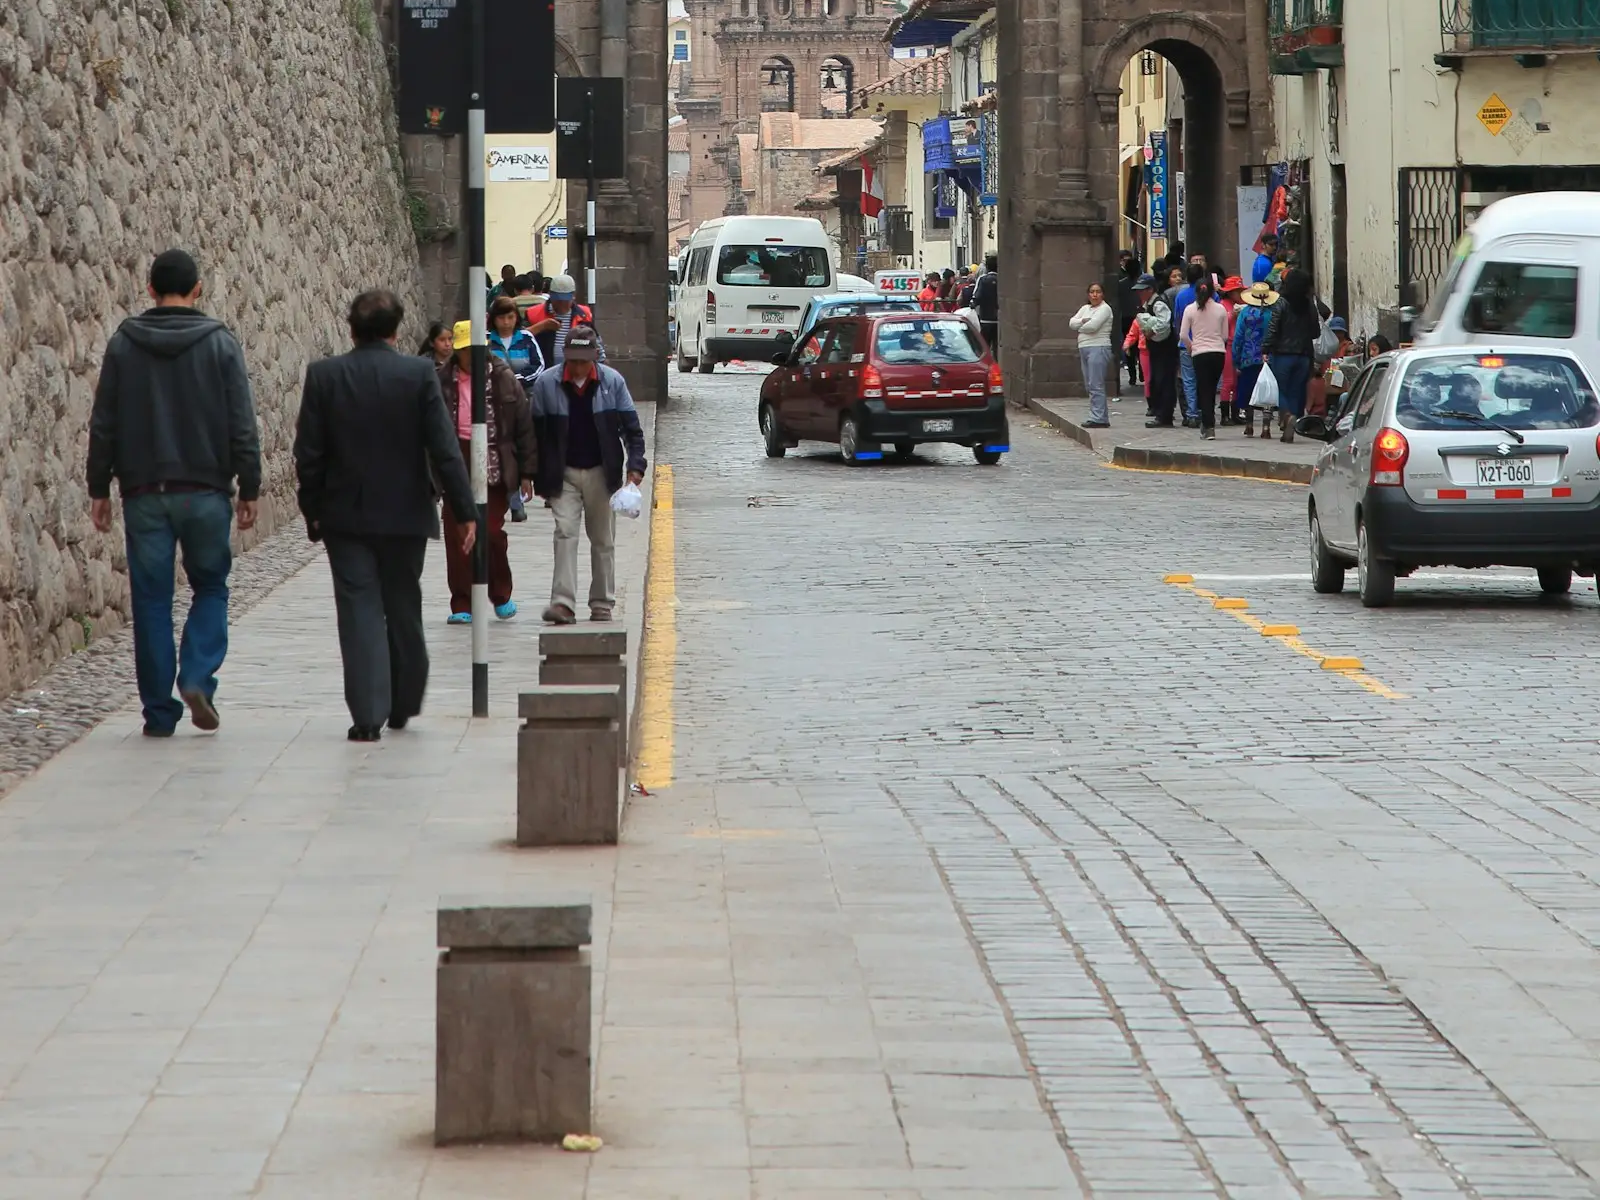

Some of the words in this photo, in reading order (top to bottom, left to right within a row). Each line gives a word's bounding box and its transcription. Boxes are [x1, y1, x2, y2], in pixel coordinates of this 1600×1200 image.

[411, 8, 424, 18] DEL
[425, 8, 449, 18] CUSCO
[421, 19, 438, 29] 2013
[1152, 140, 1164, 228] FOTOCOPIAS
[880, 277, 920, 291] 241557
[1480, 465, 1531, 482] X2T-060
